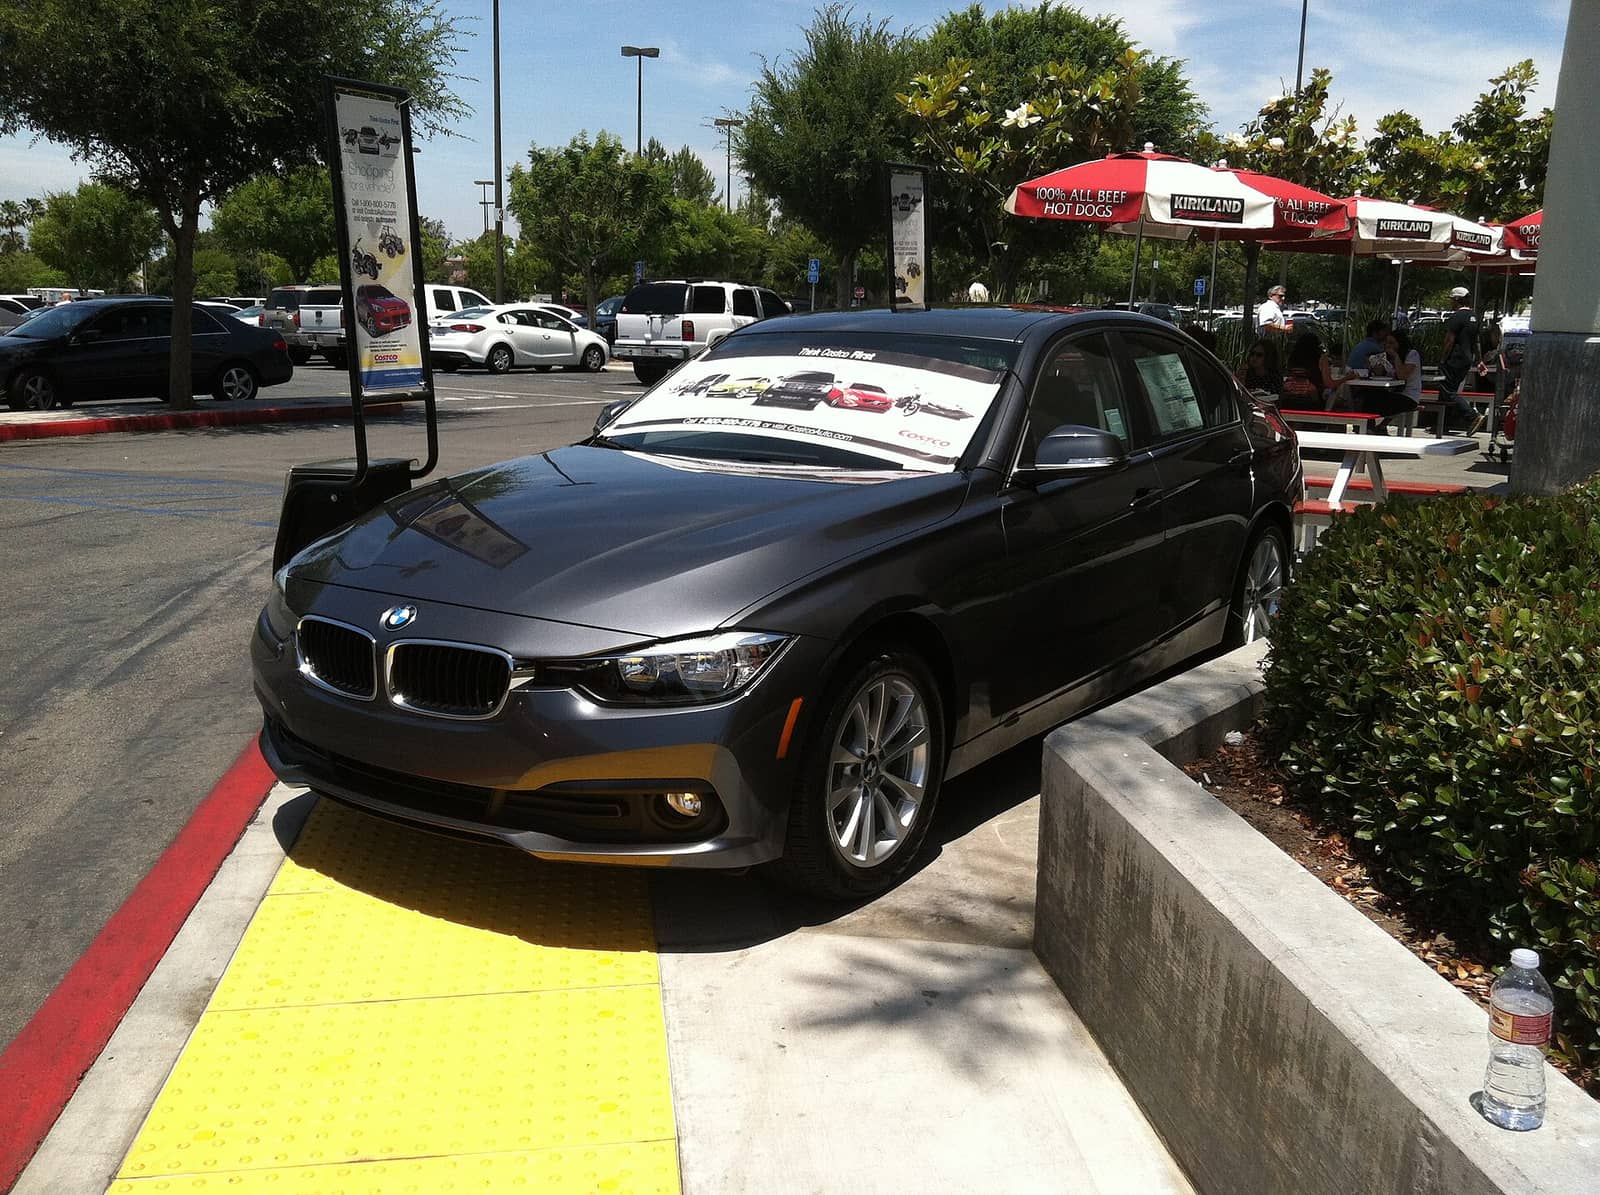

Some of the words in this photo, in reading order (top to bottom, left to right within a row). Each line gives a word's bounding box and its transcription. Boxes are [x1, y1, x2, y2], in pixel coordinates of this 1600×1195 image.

[1036, 187, 1066, 200] 100%
[1069, 188, 1093, 202] ALL
[1097, 190, 1127, 204] BEEF
[1044, 202, 1072, 215] HOT
[1075, 203, 1113, 218] DOGS
[1174, 195, 1242, 214] KIRKLAND
[1286, 198, 1304, 211] ALL
[1307, 200, 1331, 214] BEEF
[1291, 211, 1319, 225] DOGS
[1380, 220, 1430, 233] KIRKLAND
[1456, 231, 1490, 245] KIRKLAND
[1526, 235, 1541, 245] HO
[798, 347, 821, 357] Think
[820, 348, 850, 358] Costco
[850, 350, 876, 361] First
